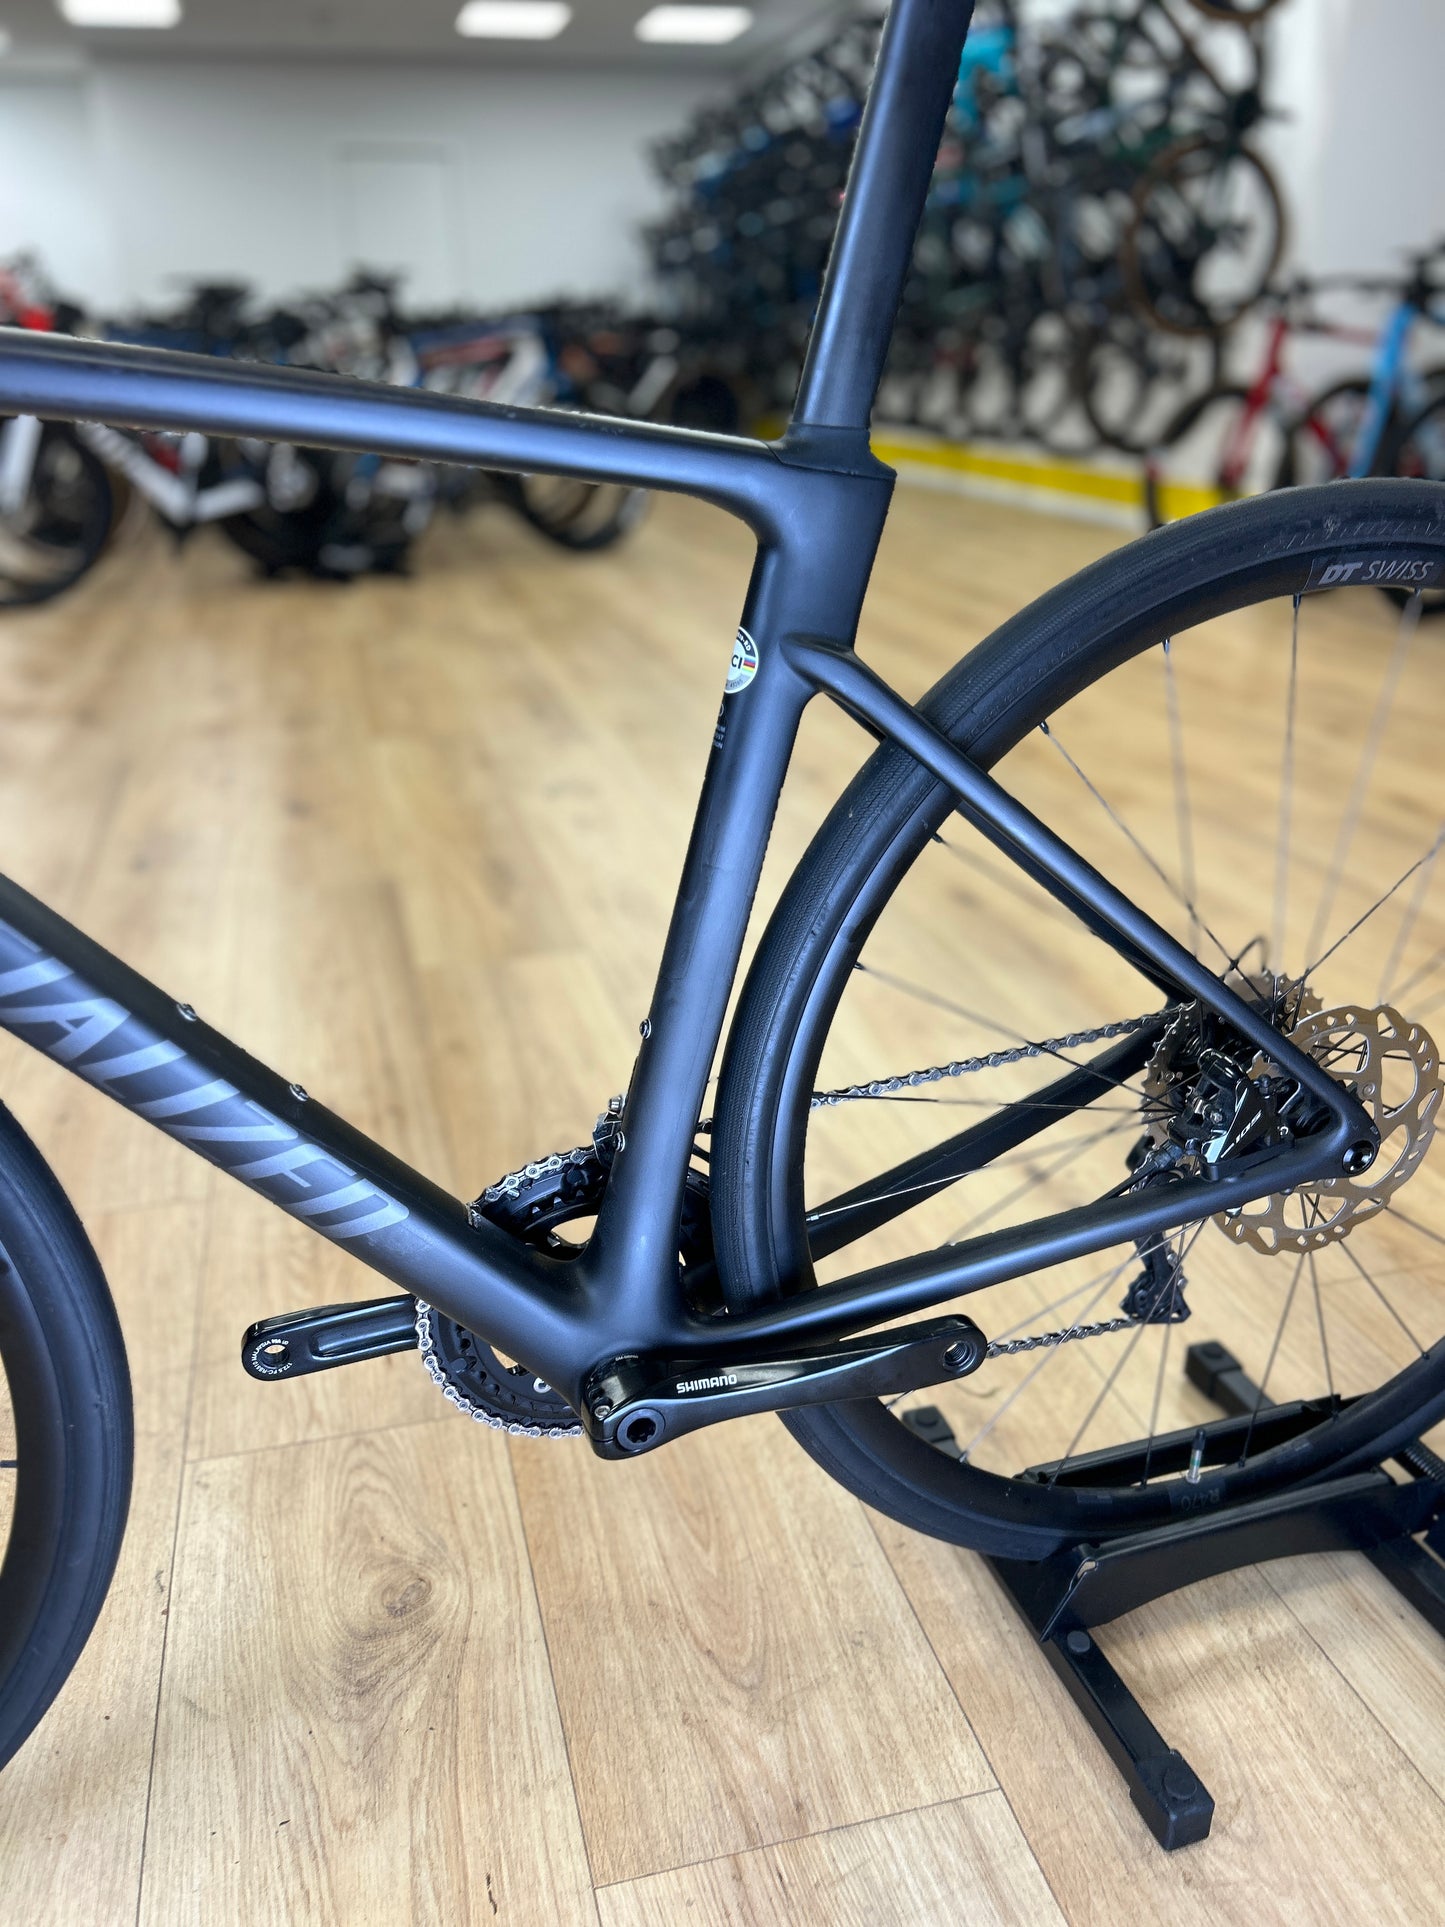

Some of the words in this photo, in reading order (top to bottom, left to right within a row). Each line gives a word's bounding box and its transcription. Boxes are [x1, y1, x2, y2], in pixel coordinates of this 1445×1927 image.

[1318, 562, 1364, 585] DT
[1361, 560, 1435, 581] SWISS
[676, 1374, 738, 1394] SHIMANO
